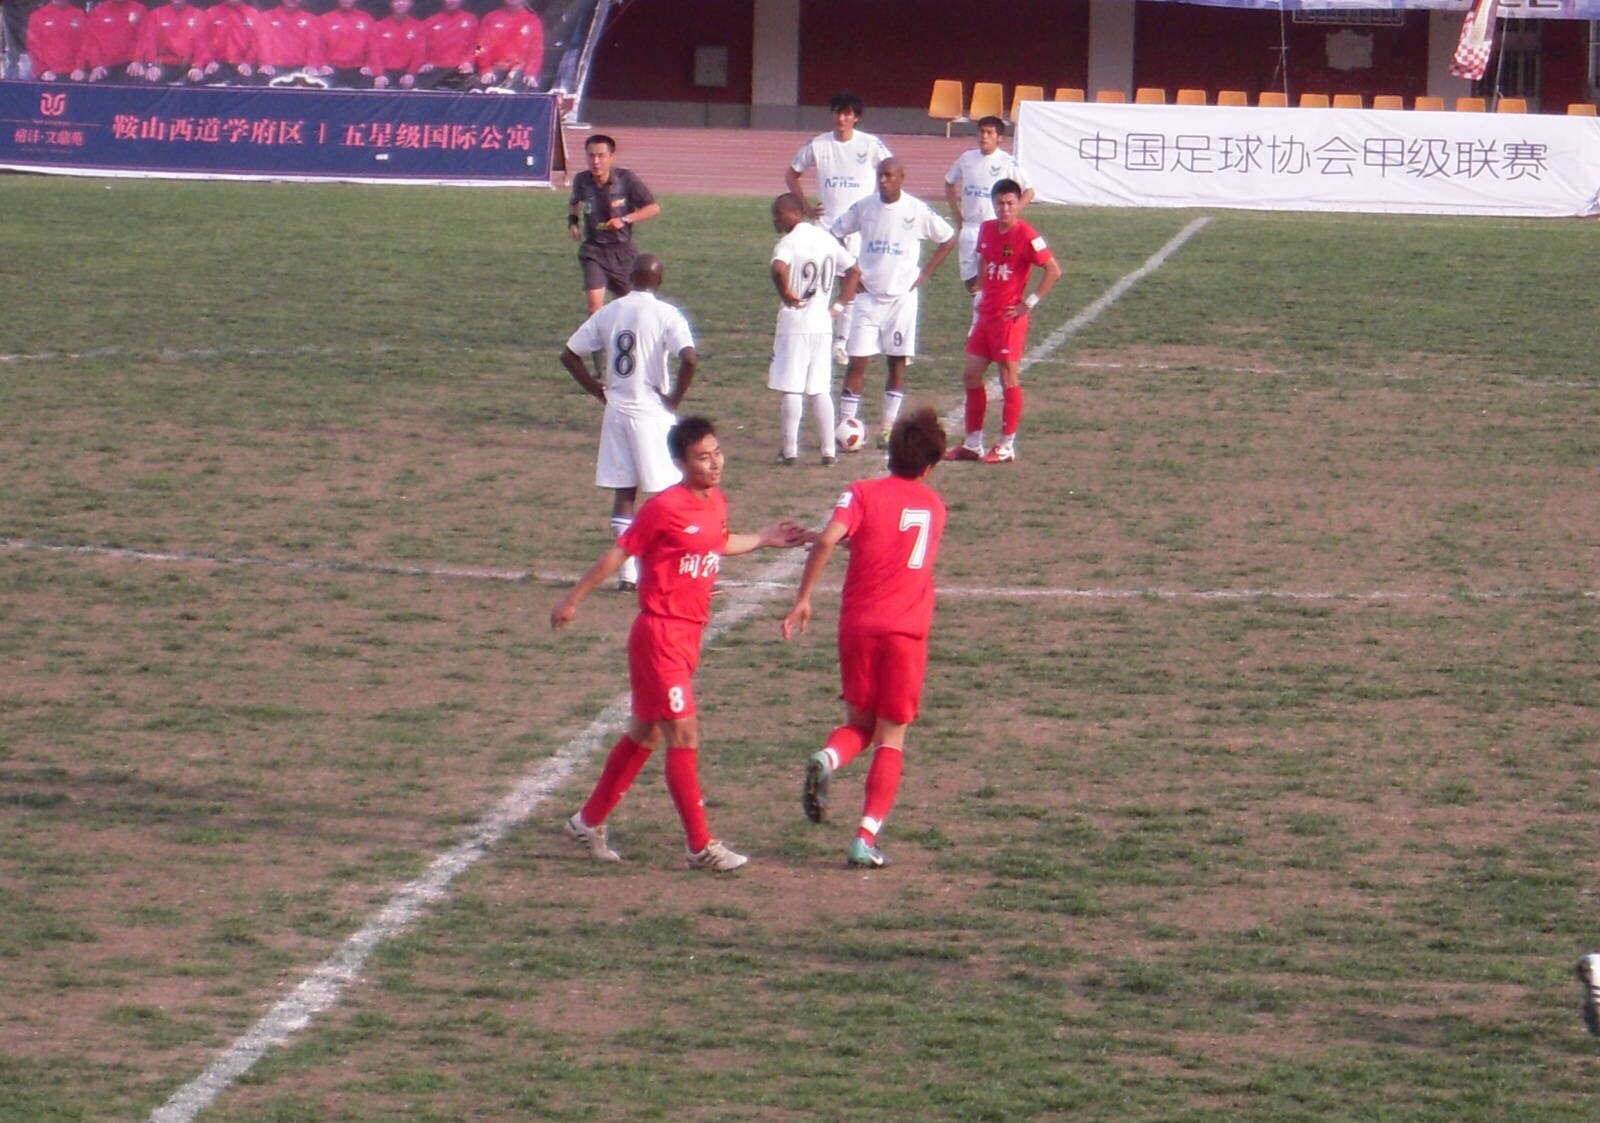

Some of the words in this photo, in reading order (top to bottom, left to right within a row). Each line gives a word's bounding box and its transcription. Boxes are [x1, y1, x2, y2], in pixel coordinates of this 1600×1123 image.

[112, 114, 304, 144] 鞍山西道学府区
[340, 121, 533, 150] 五星级国际公寓
[1079, 131, 1548, 181] 中国足球协会甲级联赛
[801, 256, 834, 299] 20
[614, 329, 636, 379] 8
[893, 331, 903, 347] 9
[900, 508, 931, 570] 7
[668, 686, 685, 712] 8
